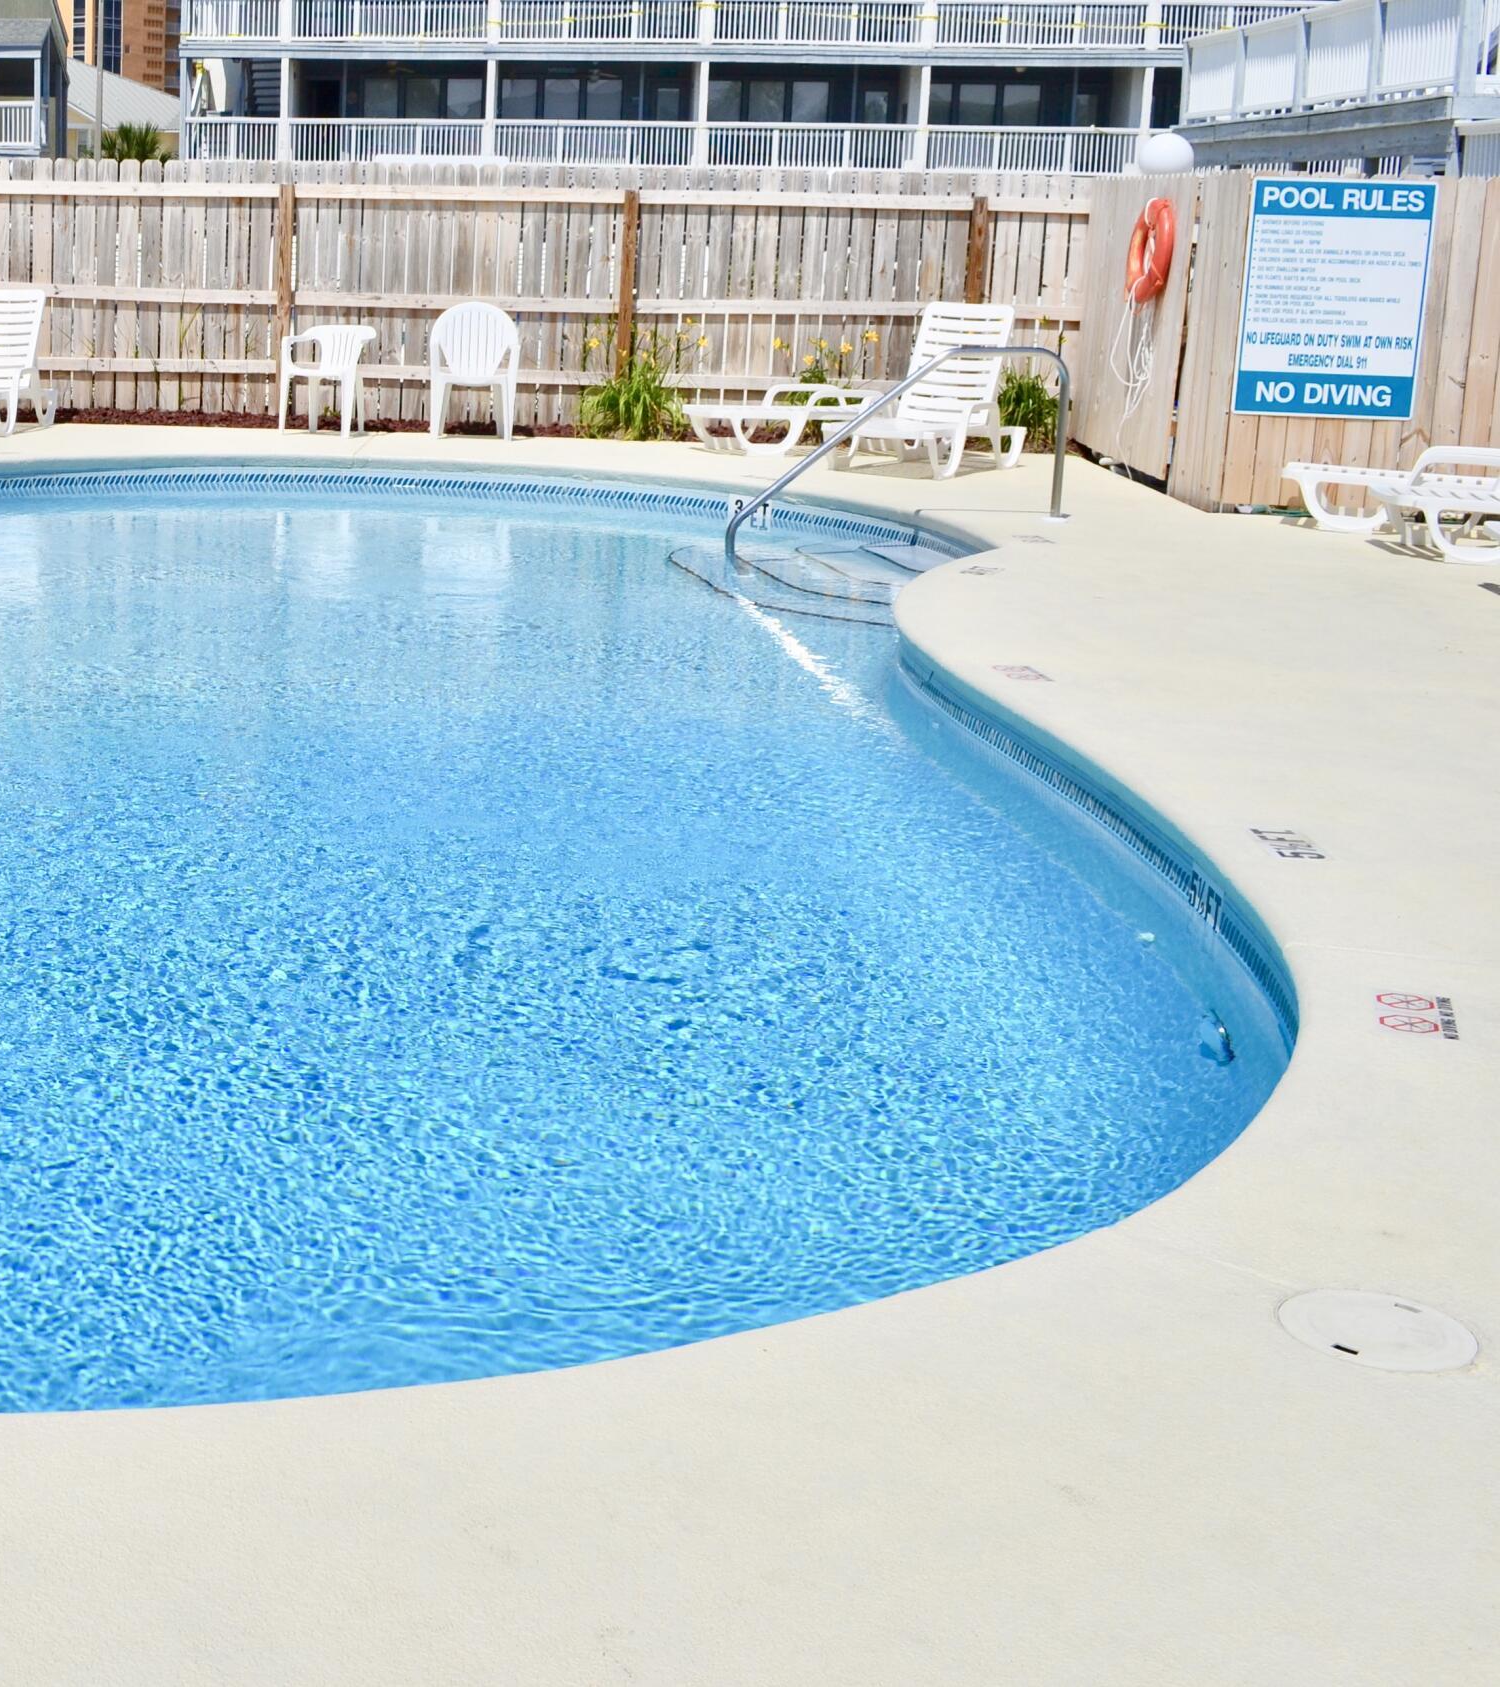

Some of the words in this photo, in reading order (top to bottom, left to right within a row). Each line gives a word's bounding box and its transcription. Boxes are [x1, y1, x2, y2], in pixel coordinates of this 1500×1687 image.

[1262, 186, 1334, 210] POOL
[1342, 188, 1426, 212] RULES
[1246, 332, 1257, 344] NO
[1259, 332, 1301, 346] LIFEGUARD
[1304, 334, 1315, 347] ON
[1317, 334, 1339, 347] DUTY
[1340, 335, 1361, 348] SWIM
[1363, 335, 1373, 348] AT
[1375, 336, 1392, 349] OWN
[1395, 337, 1413, 350] RISK
[1287, 353, 1334, 368] EMERGENCY
[1336, 355, 1354, 369] DIAL
[1356, 356, 1368, 369] 911
[1255, 381, 1295, 403] NO
[1303, 383, 1393, 407] DIVING
